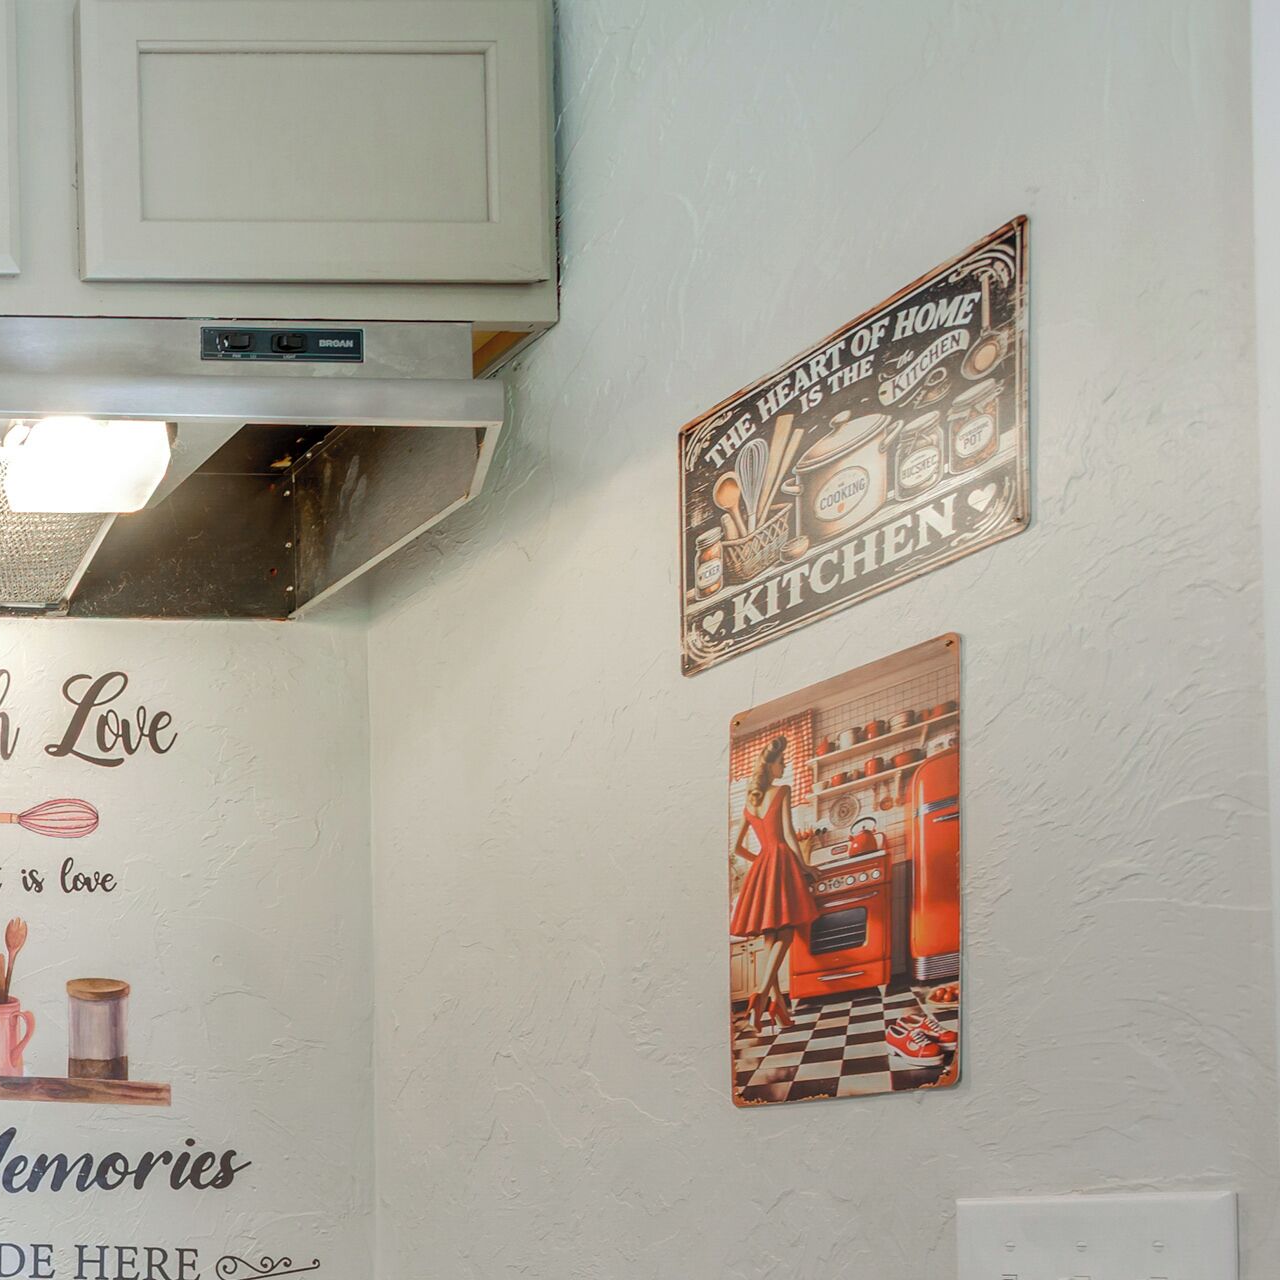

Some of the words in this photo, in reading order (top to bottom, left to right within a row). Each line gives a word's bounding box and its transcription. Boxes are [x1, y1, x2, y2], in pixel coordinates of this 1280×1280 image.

[318, 339, 354, 348] BROAN
[886, 349, 915, 370] the
[891, 331, 962, 400] KITCHEN
[704, 412, 757, 468] THE
[755, 340, 846, 424] HEART
[850, 316, 890, 357] OF
[891, 292, 982, 342] HOME
[798, 386, 824, 414] IS
[827, 354, 876, 395] THE
[963, 430, 983, 450] POT
[821, 478, 866, 510] COOKING
[730, 494, 957, 635] KITCHEN
[44, 671, 178, 767] Love
[21, 867, 44, 894] is
[60, 857, 118, 894] love
